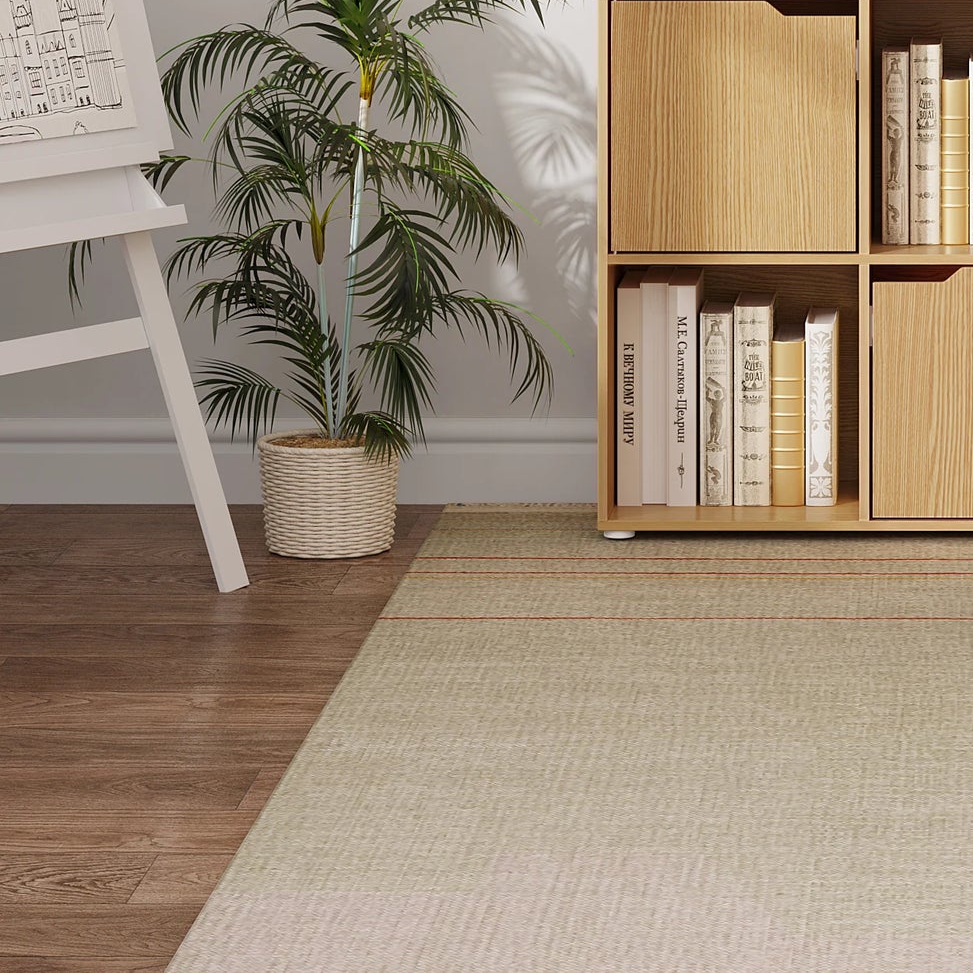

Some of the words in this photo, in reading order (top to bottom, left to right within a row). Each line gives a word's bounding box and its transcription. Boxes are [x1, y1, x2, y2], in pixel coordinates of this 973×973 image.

[677, 316, 688, 339] М.Е.
[623, 343, 635, 351] К
[623, 353, 635, 407] ВЕЧНОМУ
[674, 341, 688, 443] Салтыков-Щедрин
[623, 411, 635, 446] МИРУ
